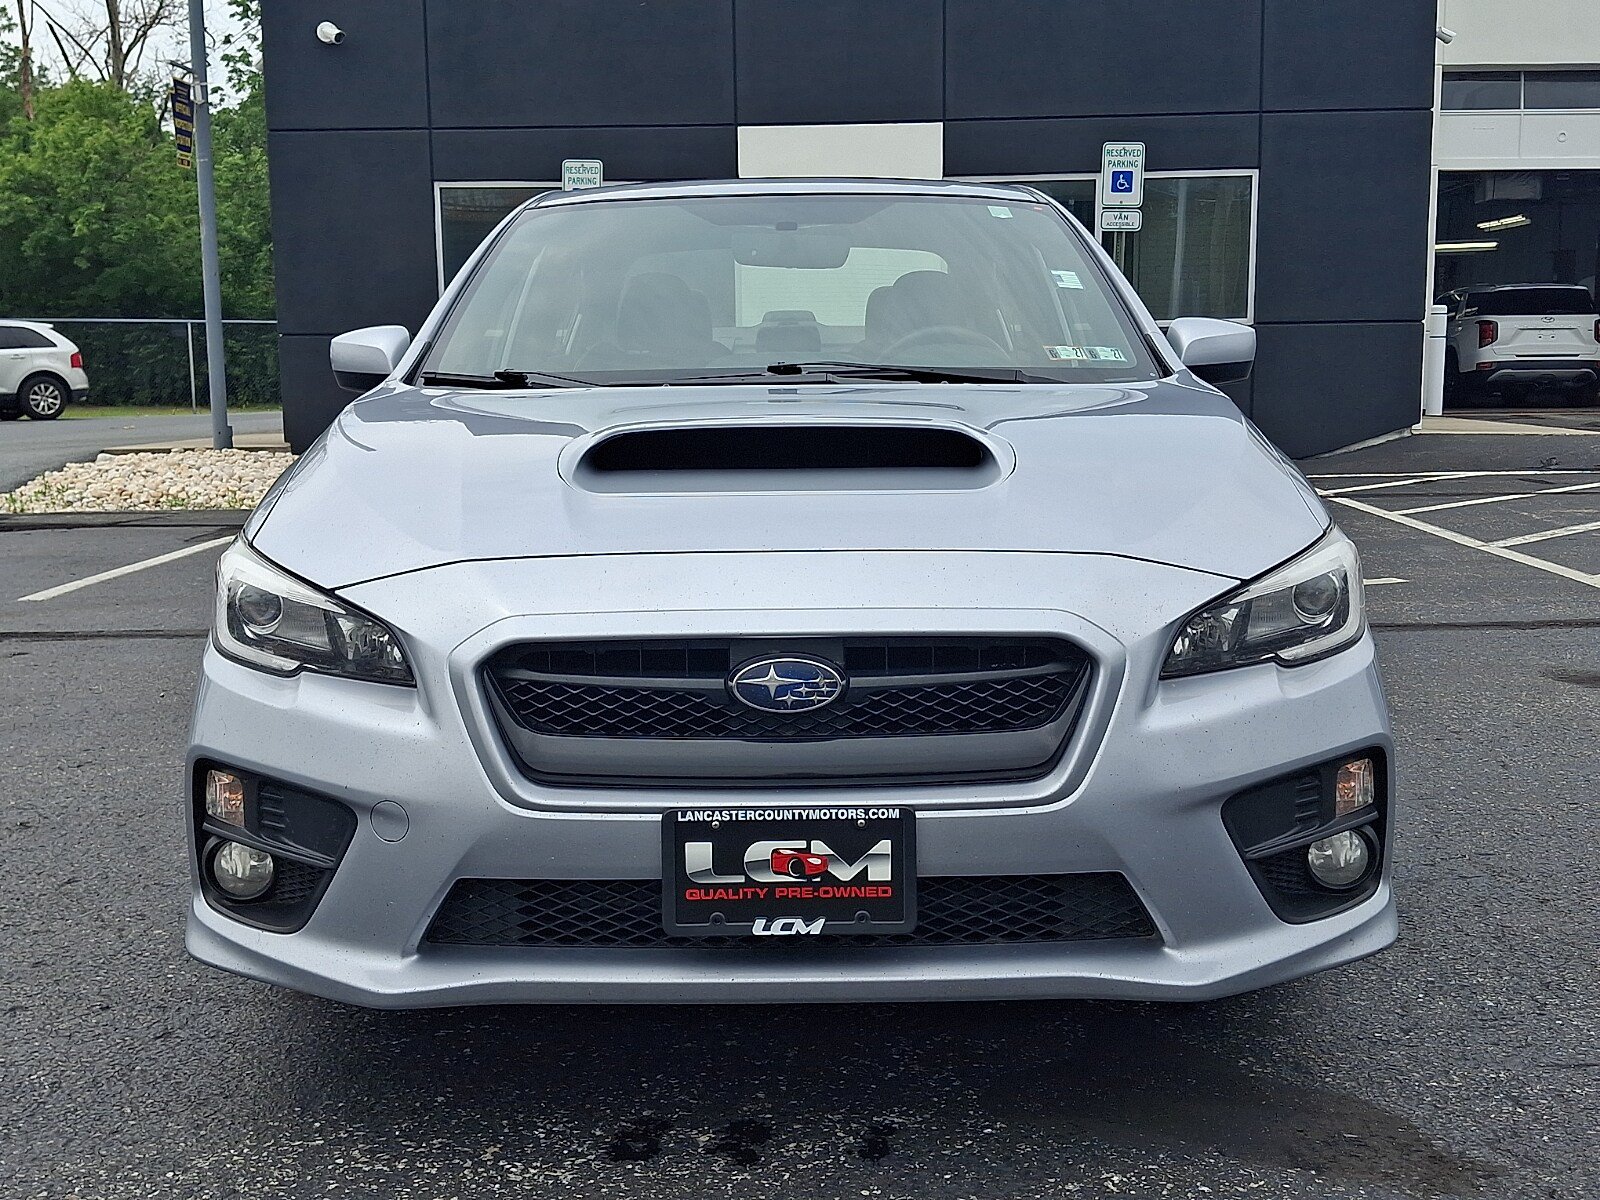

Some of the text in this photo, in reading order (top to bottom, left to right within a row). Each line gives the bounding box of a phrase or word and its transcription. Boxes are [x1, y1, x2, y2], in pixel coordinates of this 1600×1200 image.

[1106, 149, 1142, 157] RESERVED
[1107, 160, 1139, 168] PARKING
[565, 166, 599, 175] RESERVED
[567, 177, 597, 185] PARKING
[1113, 213, 1129, 221] VAN
[677, 808, 900, 822] LANCASTERCOUNTYMOTORS.COM
[685, 839, 892, 883] LCM
[685, 886, 892, 900] QUALITY PRE-OWNED
[752, 916, 826, 935] LCM
